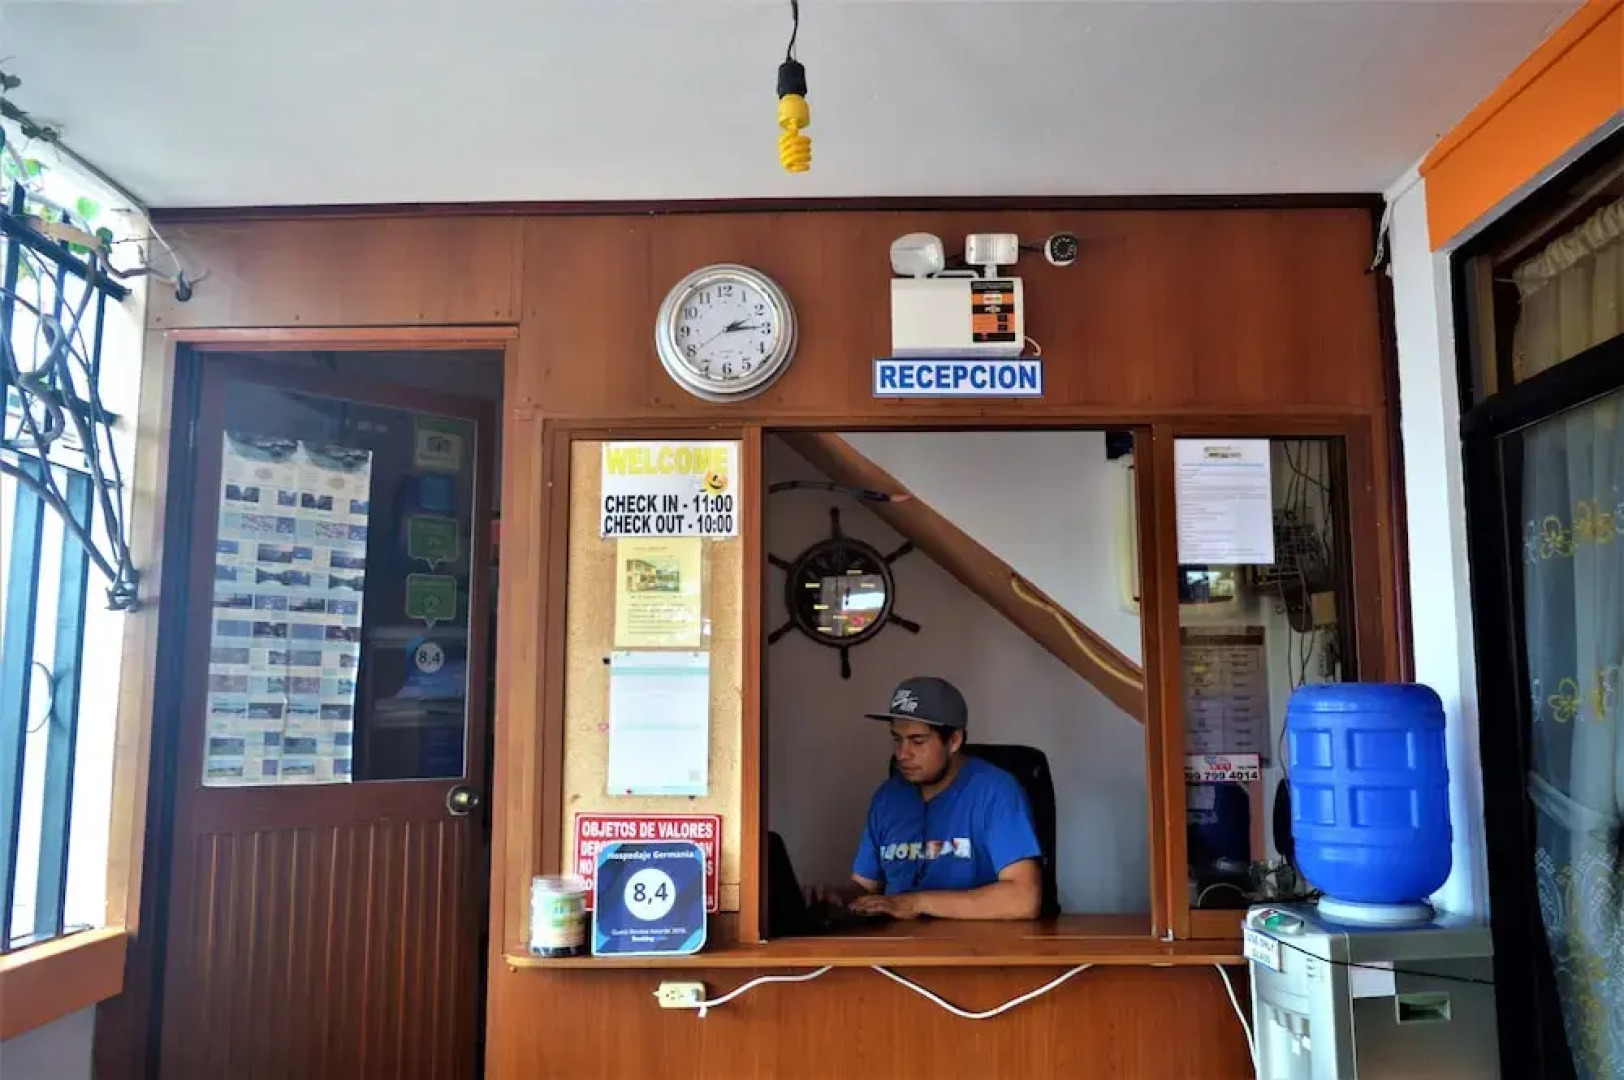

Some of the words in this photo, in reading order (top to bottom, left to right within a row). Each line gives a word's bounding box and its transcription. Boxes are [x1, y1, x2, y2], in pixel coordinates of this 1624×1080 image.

[717, 285, 733, 297] 12
[699, 292, 710, 304] 11
[684, 306, 698, 319] 10
[754, 304, 764, 316] 2
[680, 325, 690, 337] 9
[760, 322, 771, 334] 3
[686, 344, 696, 357] 8
[755, 341, 764, 354] 4
[722, 362, 732, 374] 6
[741, 357, 751, 371] 5
[879, 364, 1037, 389] RECEPCION
[605, 446, 729, 475] WELCOME
[605, 494, 657, 514] CHECK
[662, 494, 679, 513] IN
[693, 494, 733, 513] 11:00
[604, 514, 651, 534] CHECK
[655, 514, 684, 534] OUT
[697, 514, 733, 534] 10:00
[582, 821, 636, 839] OBJETOS
[639, 821, 656, 838] DE
[658, 821, 713, 839] VALORES
[607, 850, 652, 862] Hospedaje
[652, 850, 695, 859] Germania
[633, 881, 668, 905] 8,4
